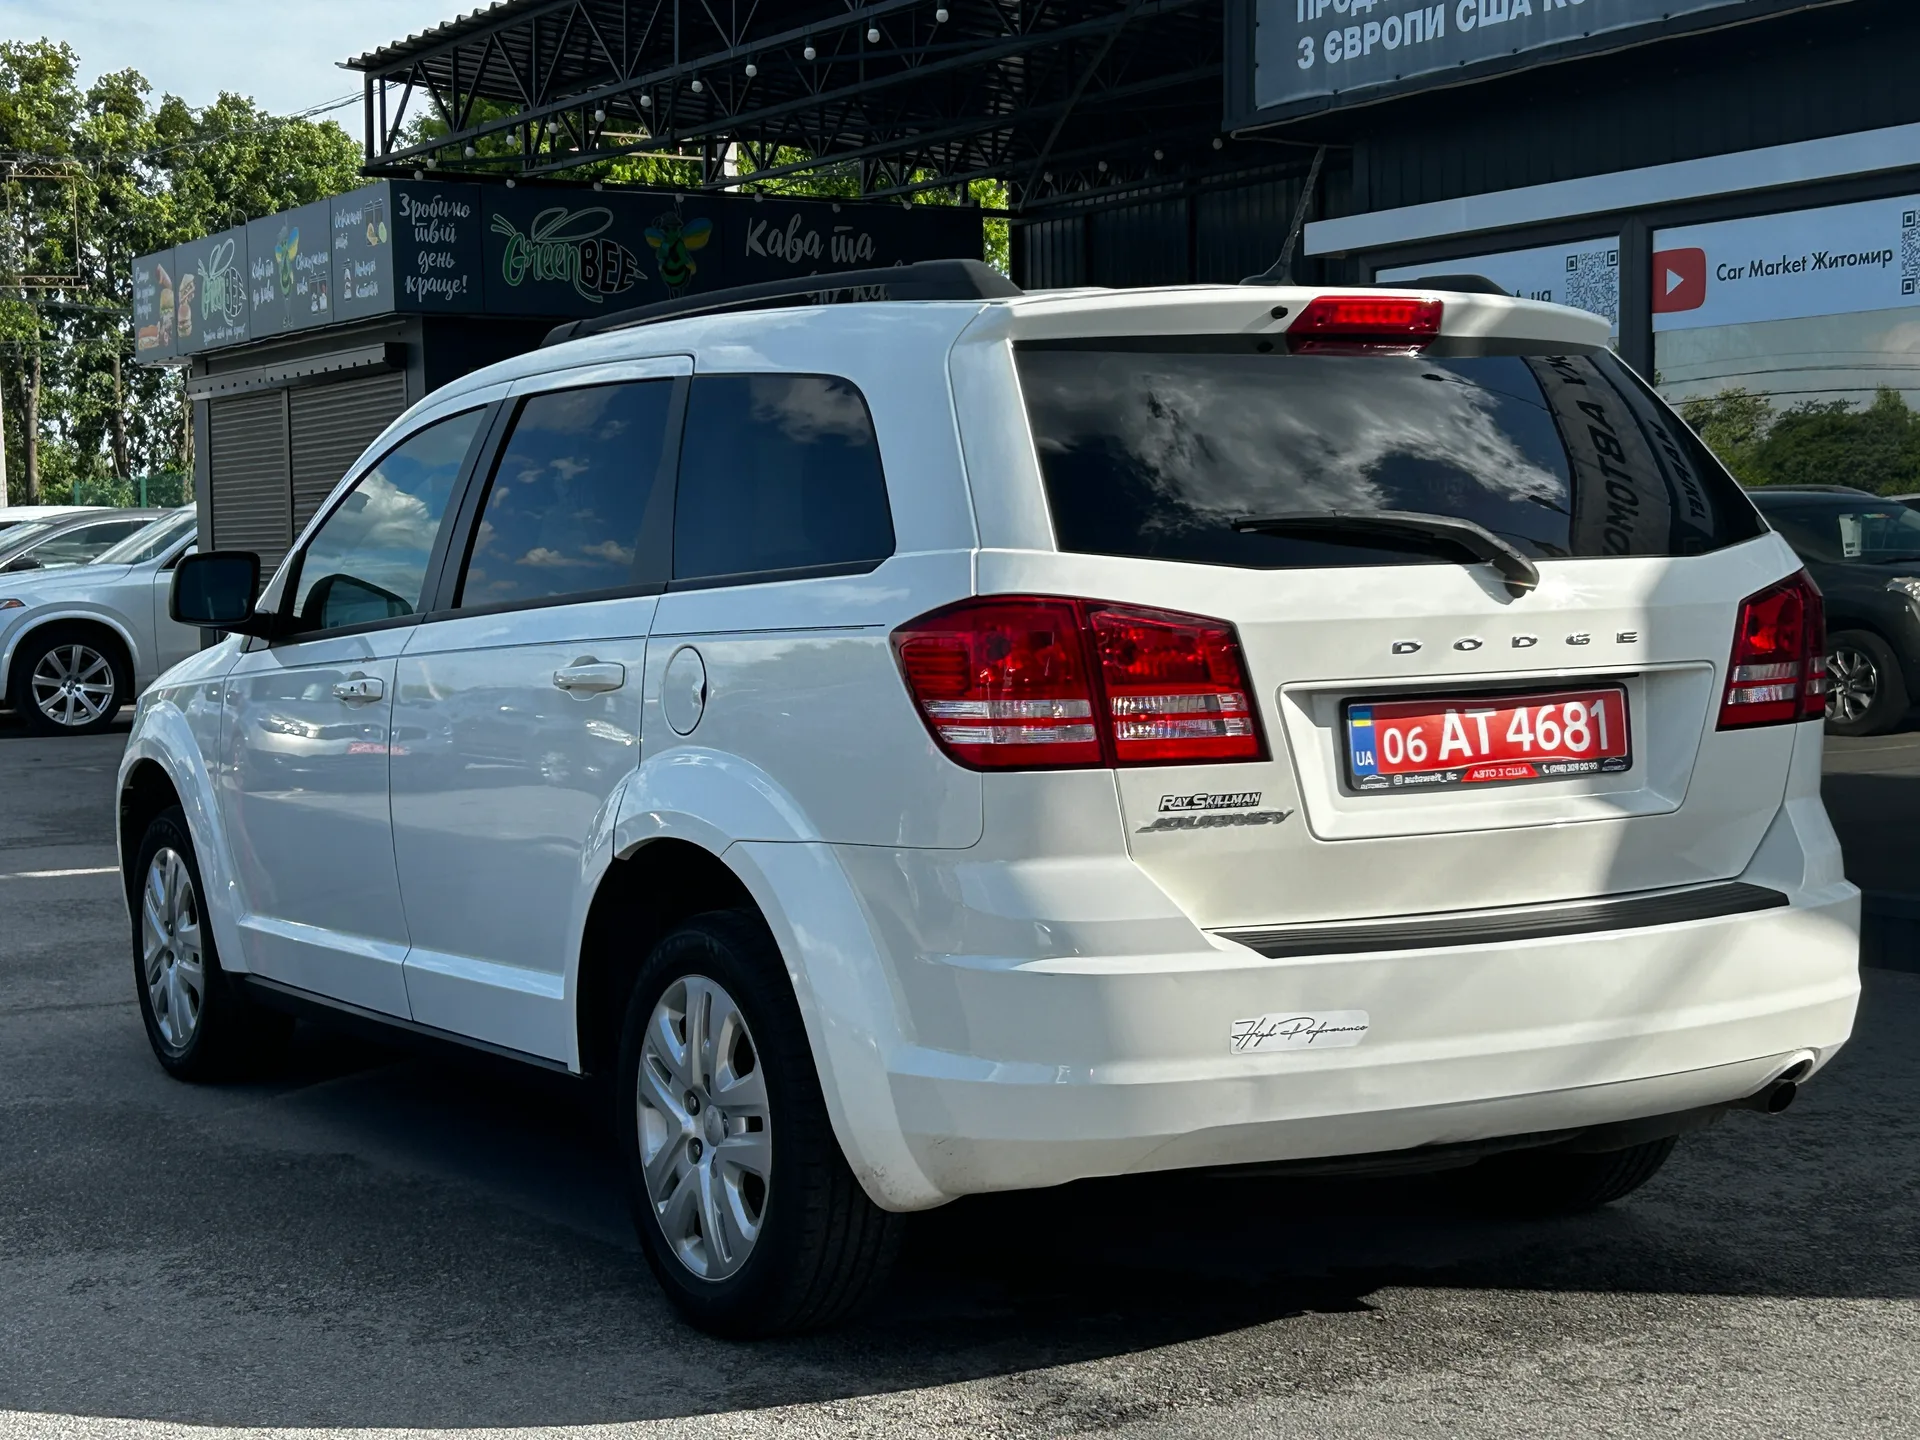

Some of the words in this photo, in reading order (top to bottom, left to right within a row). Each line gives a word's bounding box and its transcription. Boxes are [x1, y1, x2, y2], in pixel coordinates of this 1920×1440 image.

[1297, 36, 1315, 70] З
[1323, 3, 1445, 64] ЄВРОПИ
[1455, 0, 1532, 32] США
[399, 193, 471, 225] Зробимо
[415, 218, 457, 243] твій
[745, 213, 824, 264] Кава
[831, 226, 877, 264] та
[418, 251, 456, 274] день
[1716, 263, 1745, 281] Car
[1748, 255, 1807, 278] Market
[1811, 249, 1893, 272] Житомир
[405, 275, 467, 303] краще!
[1392, 631, 1637, 654] DODGE
[1383, 726, 1427, 764] 06
[1438, 708, 1497, 760] AT
[1506, 699, 1608, 752] 4681
[1356, 751, 1374, 765] UA
[1160, 795, 1191, 810] RAY
[1193, 792, 1260, 809] SKILLMAN
[1231, 1018, 1277, 1049] High
